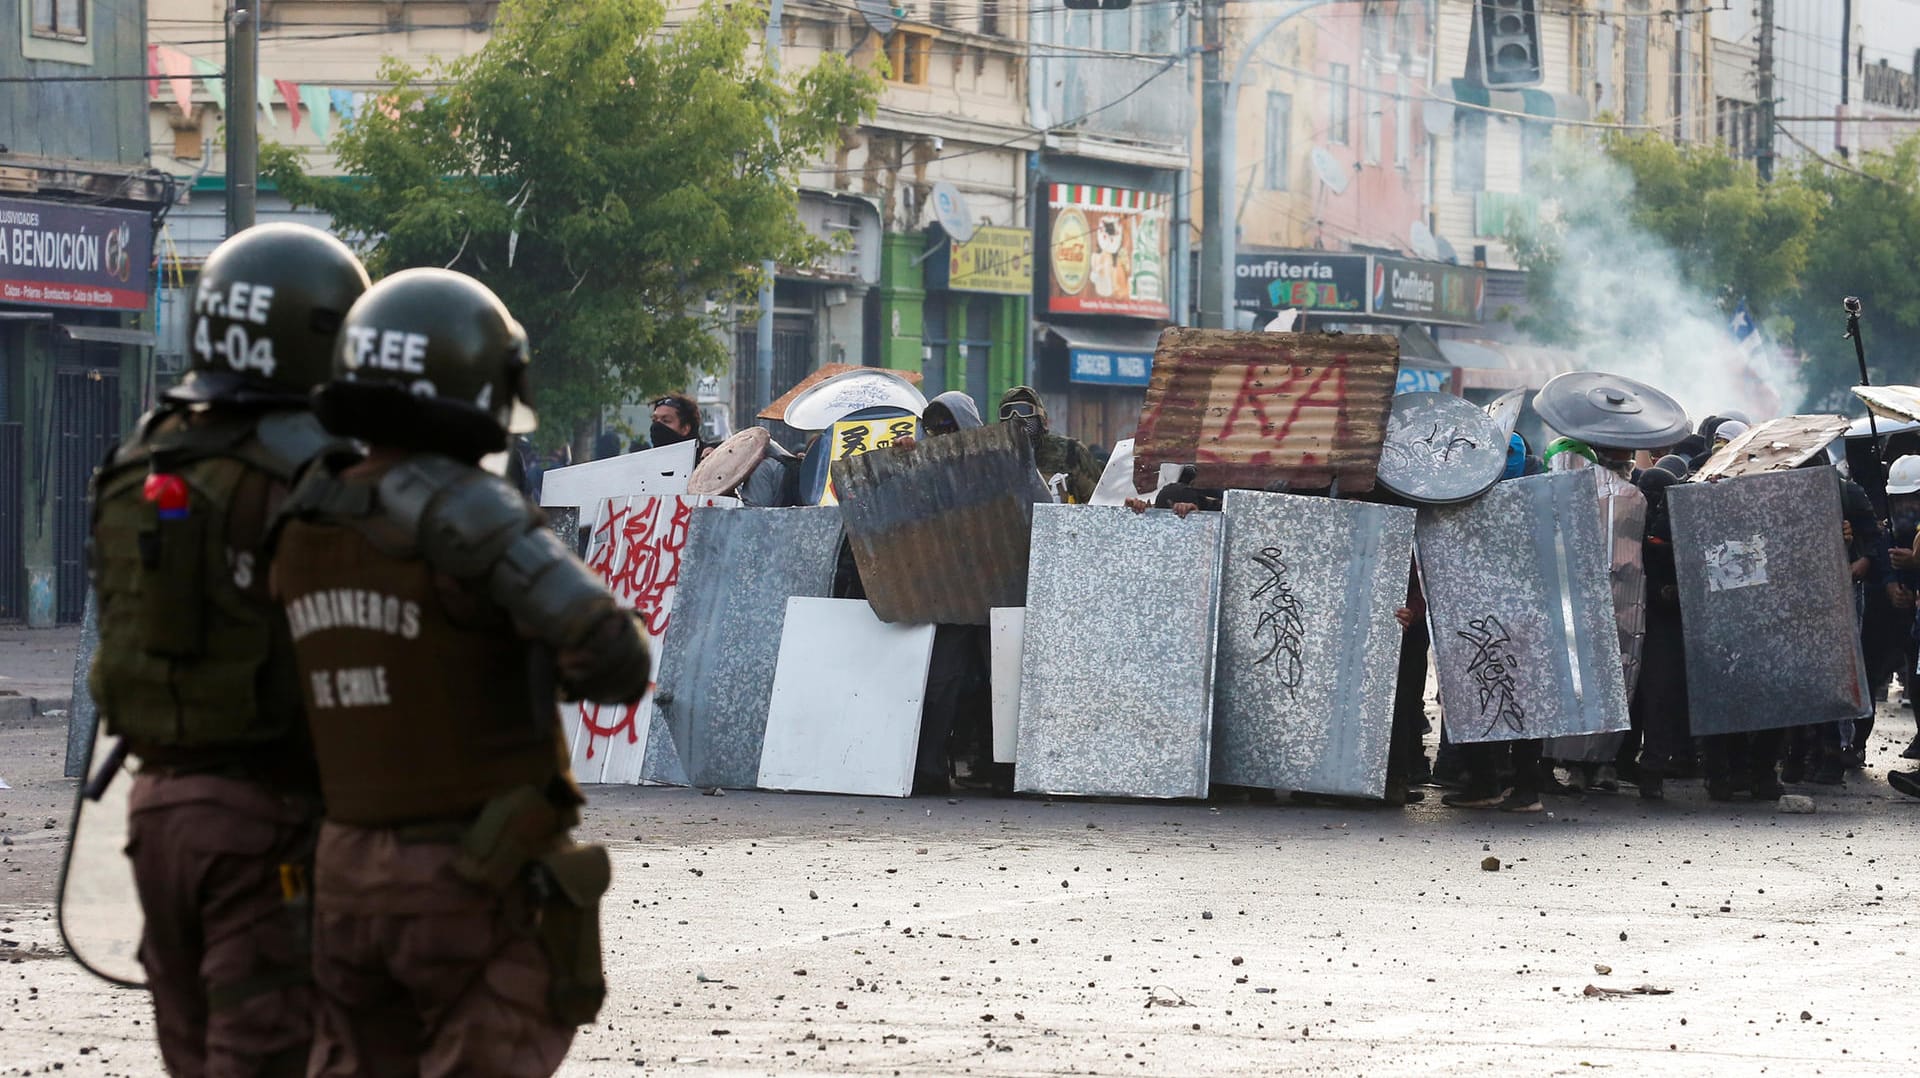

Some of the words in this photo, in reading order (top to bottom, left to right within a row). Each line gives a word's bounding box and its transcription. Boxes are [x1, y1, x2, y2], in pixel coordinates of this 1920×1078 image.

[12, 226, 99, 273] BENDICIÓN
[1236, 260, 1333, 279] onfitería
[1267, 278, 1338, 307] FIESTA
[194, 316, 277, 378] 4-04
[336, 666, 392, 708] CHILE
